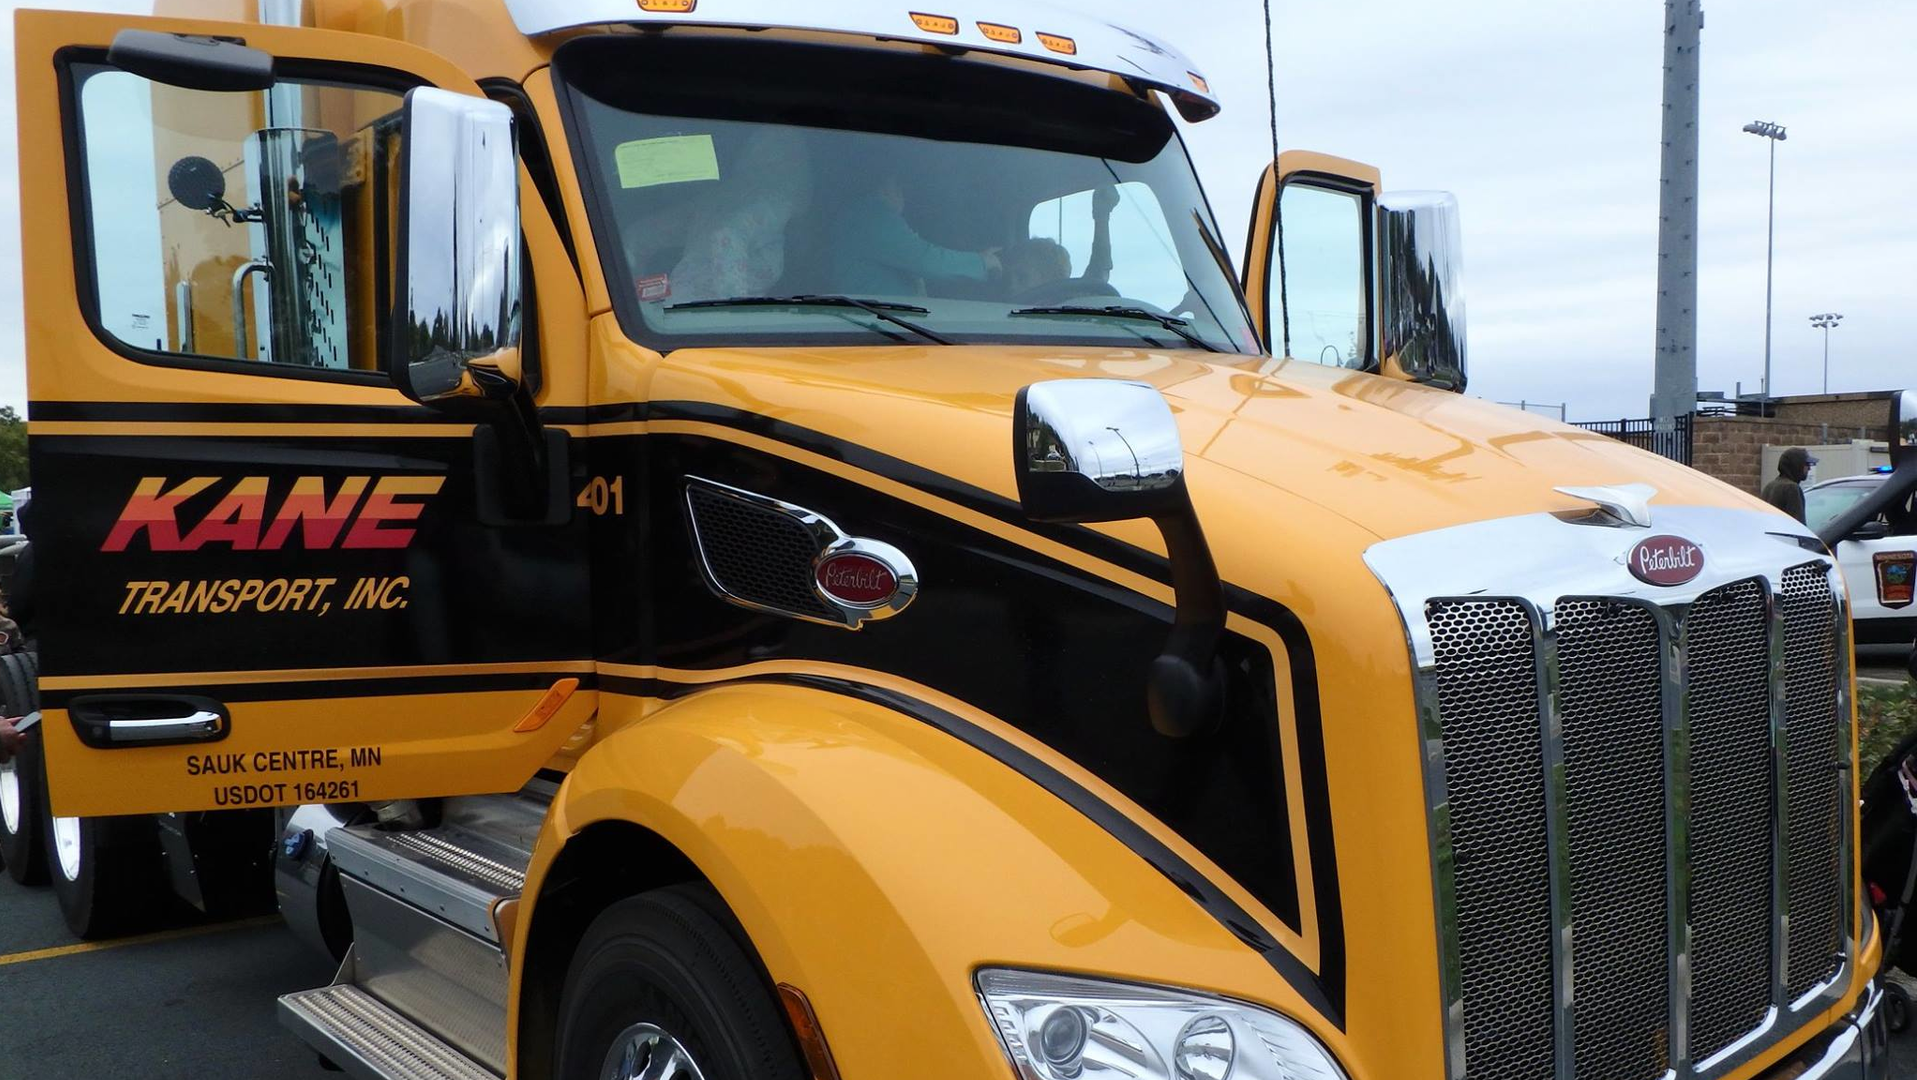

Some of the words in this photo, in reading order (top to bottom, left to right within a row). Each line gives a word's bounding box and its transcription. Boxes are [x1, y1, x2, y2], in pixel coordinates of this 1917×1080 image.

[576, 475, 623, 515] 401
[101, 476, 447, 551] KANE
[1640, 545, 1696, 574] Peterbilt
[825, 562, 887, 590] Peterbilt
[118, 579, 337, 617] TRANSPORT,
[343, 576, 410, 609] INC.
[187, 754, 247, 775] SAUK
[252, 750, 344, 771] CENTRE,
[351, 747, 381, 767] MN
[214, 784, 286, 805] USDOT
[294, 781, 359, 800] 164261
